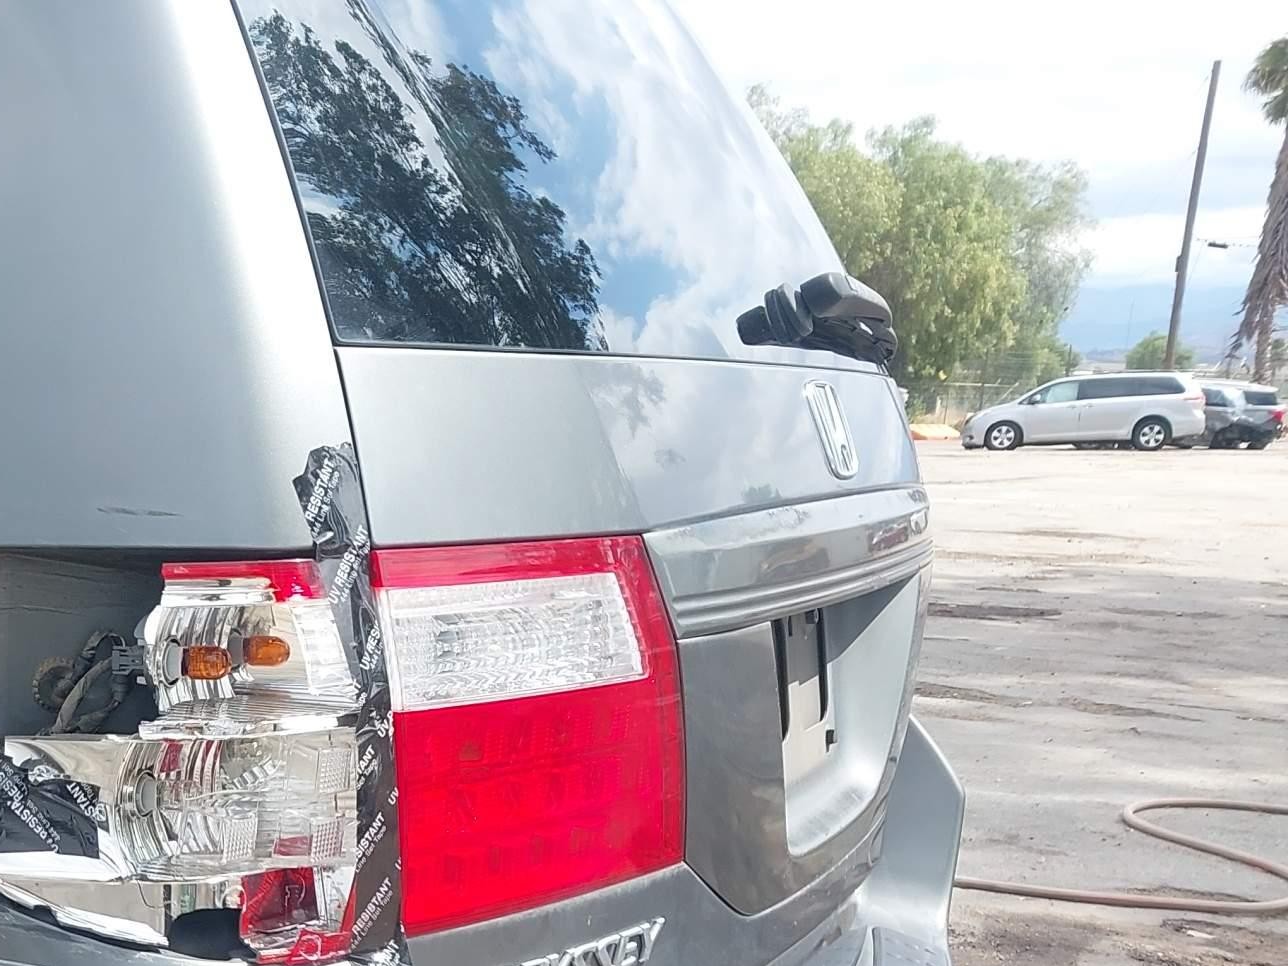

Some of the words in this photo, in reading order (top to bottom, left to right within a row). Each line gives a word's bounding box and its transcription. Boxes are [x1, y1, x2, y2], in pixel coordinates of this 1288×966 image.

[305, 459, 335, 521] RESISTANT
[328, 586, 340, 604] UV
[336, 524, 368, 585] RESISTANT
[359, 652, 371, 670] UV
[388, 786, 399, 806] UV
[352, 876, 392, 936] RESISTANT
